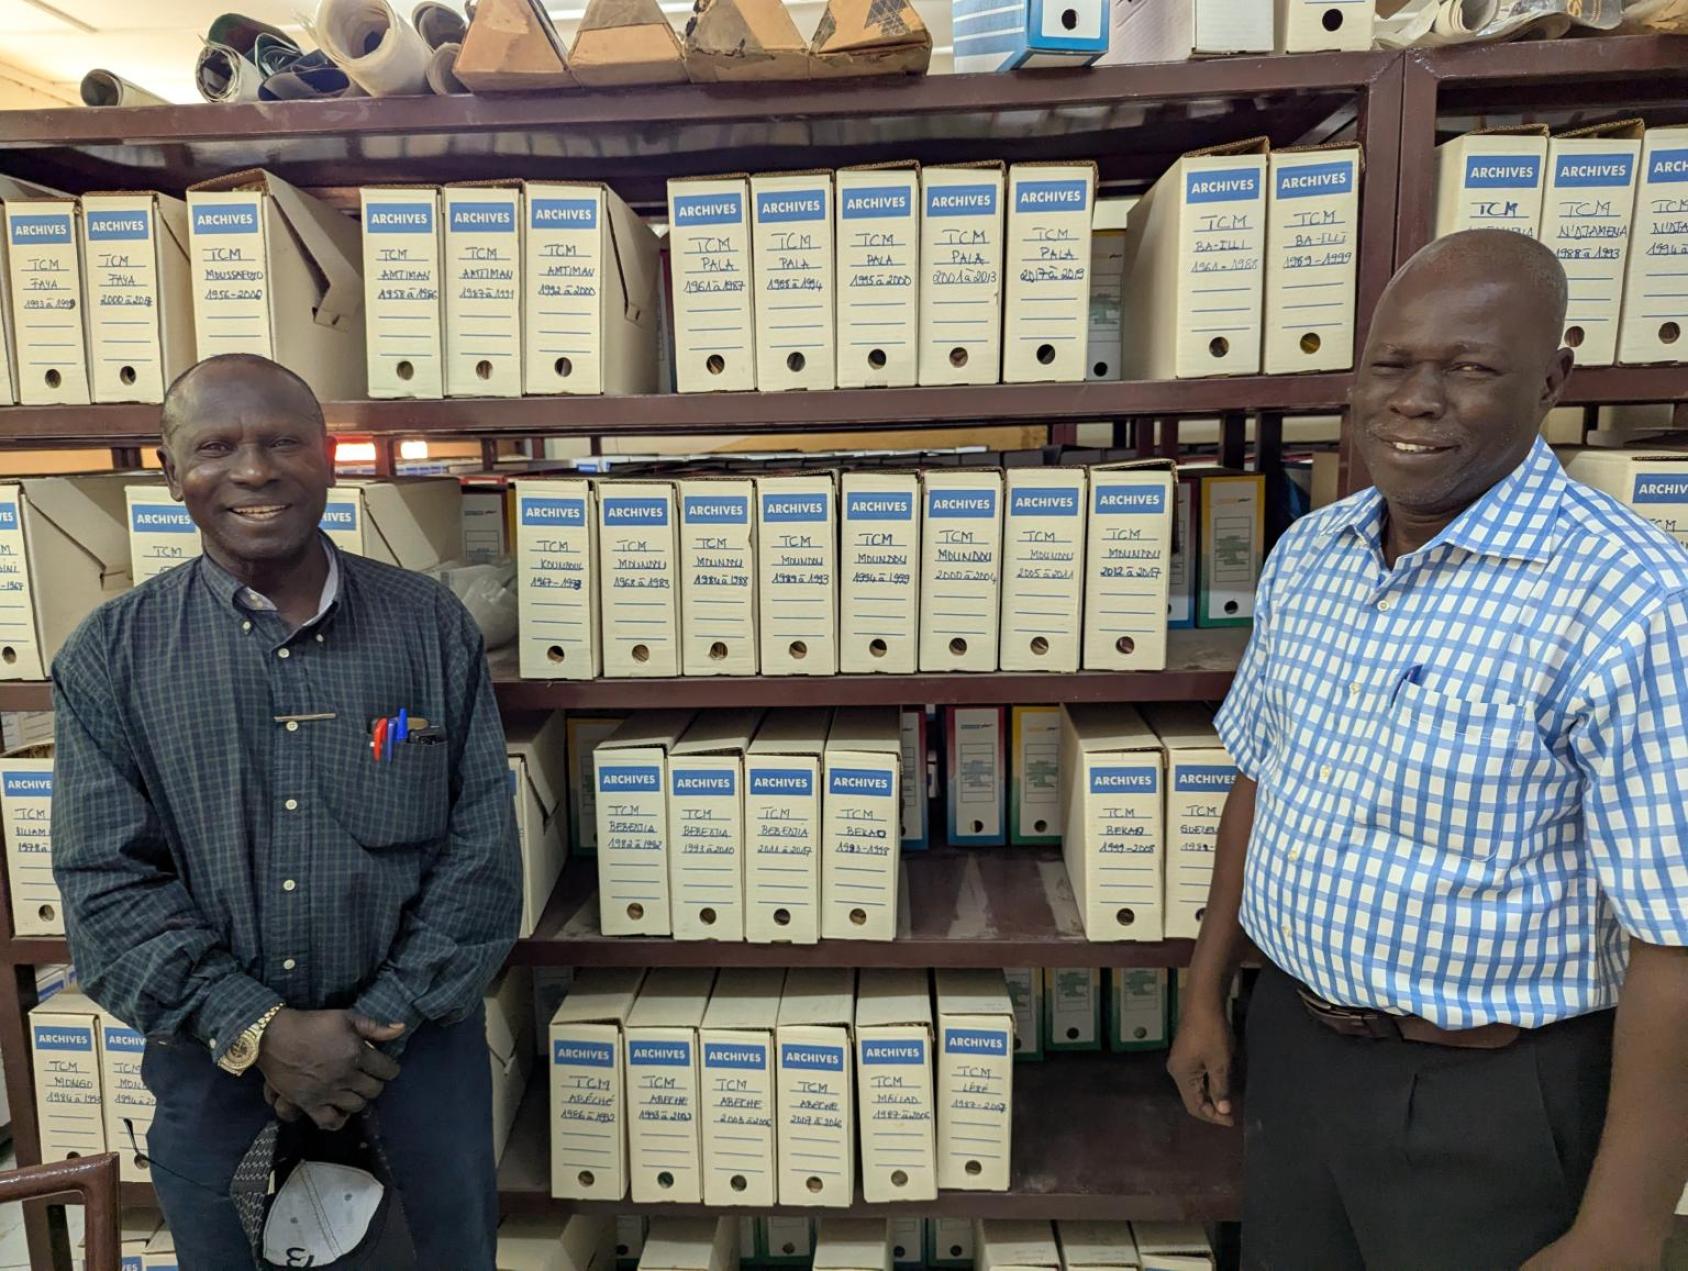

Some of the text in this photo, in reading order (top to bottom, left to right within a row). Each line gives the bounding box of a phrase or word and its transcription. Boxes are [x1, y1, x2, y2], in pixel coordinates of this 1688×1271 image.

[1470, 166, 1534, 178] ARCHIVES
[1560, 165, 1627, 178] ARCHIVES
[1654, 161, 1688, 173] ARCH
[1191, 179, 1254, 194] ARCHIVES
[1281, 172, 1346, 190] ARCHIVES
[931, 195, 991, 208] ARCHIVES
[1020, 190, 1081, 203] ARCHIVES
[762, 200, 821, 214] ARCHIVES
[847, 197, 906, 209] ARCHIVES
[1470, 201, 1519, 217] TCM
[1559, 200, 1612, 217] TCM
[535, 209, 592, 220] ARCHIVES
[678, 203, 737, 217] ARCHIVES
[197, 214, 253, 226] ARCHIVES
[371, 213, 428, 225] ARCHIVES
[454, 213, 511, 224] ARCHIVES
[1200, 214, 1248, 230] TCM
[1293, 210, 1337, 225] TCM
[15, 225, 67, 236] ARCHIVES
[91, 221, 145, 232] ARCHIVES
[1652, 221, 1688, 234] N'DJA
[855, 233, 895, 247] TCM
[942, 229, 986, 244] TCM
[1033, 227, 1069, 241] TCM
[688, 237, 731, 252] TCM
[771, 232, 811, 250] TCM
[202, 248, 242, 260] TCM
[380, 249, 408, 262] TCM
[465, 247, 498, 260] TCM
[544, 243, 577, 256] TCM
[1040, 246, 1075, 260] PALA
[98, 253, 129, 267] TCM
[867, 253, 894, 266] PALA
[951, 249, 985, 265] PALA
[27, 258, 60, 271] TCM
[701, 256, 735, 271] PALA
[779, 257, 810, 270] PALA
[29, 277, 59, 290] FAYA
[1639, 484, 1688, 494] ARCHIV
[933, 499, 991, 510] ARCHIVES
[1015, 497, 1074, 508] ARCHIVES
[1100, 495, 1160, 505] ARCHIVES
[526, 507, 580, 518] ARCHIVES
[608, 507, 664, 518] ARCHIVES
[689, 505, 744, 516] ARCHIVES
[767, 503, 823, 514] ARCHIVES
[851, 501, 908, 512] ARCHIVES
[322, 512, 352, 523] HIVES
[858, 533, 894, 546] TCM
[938, 530, 975, 544] TCM
[1022, 531, 1056, 543] TCM
[1106, 528, 1141, 540] TCM
[536, 540, 569, 552] TCM
[616, 539, 648, 552] TCM
[695, 537, 728, 549] TCM
[779, 535, 812, 548] TCM
[152, 545, 183, 557] TCM
[8, 779, 53, 790] ARCHIVE
[603, 775, 656, 784] ARCHIVES
[676, 778, 730, 788] ARCHIVES
[754, 777, 808, 788] ARCHIVES
[833, 777, 888, 789] ARCHIVES
[1094, 775, 1153, 786] ARCHIVES
[14, 807, 45, 820] TCM
[608, 804, 640, 816] TCM
[682, 808, 713, 820] TCM
[760, 806, 791, 820] TCM
[840, 808, 874, 820] TCM
[1103, 807, 1136, 818] TCM
[1186, 804, 1218, 817] TCM
[38, 1034, 88, 1045] ARCHIVES
[109, 1035, 146, 1047] ARCHIV
[949, 1037, 1003, 1049] ARCHIVES
[558, 1048, 609, 1060] ARCHIVES
[633, 1048, 686, 1059] ARCHIVES
[709, 1051, 761, 1062] ARCHIVES
[786, 1052, 839, 1064] ARCHIVES
[866, 1047, 920, 1058] ARCHIVES
[49, 1060, 78, 1074] TCM
[956, 1065, 991, 1079] TCM
[568, 1075, 611, 1091] TCM
[641, 1075, 676, 1089] TCM
[715, 1078, 748, 1091] TCM
[797, 1081, 828, 1093] TCM
[870, 1075, 903, 1088] TCM
